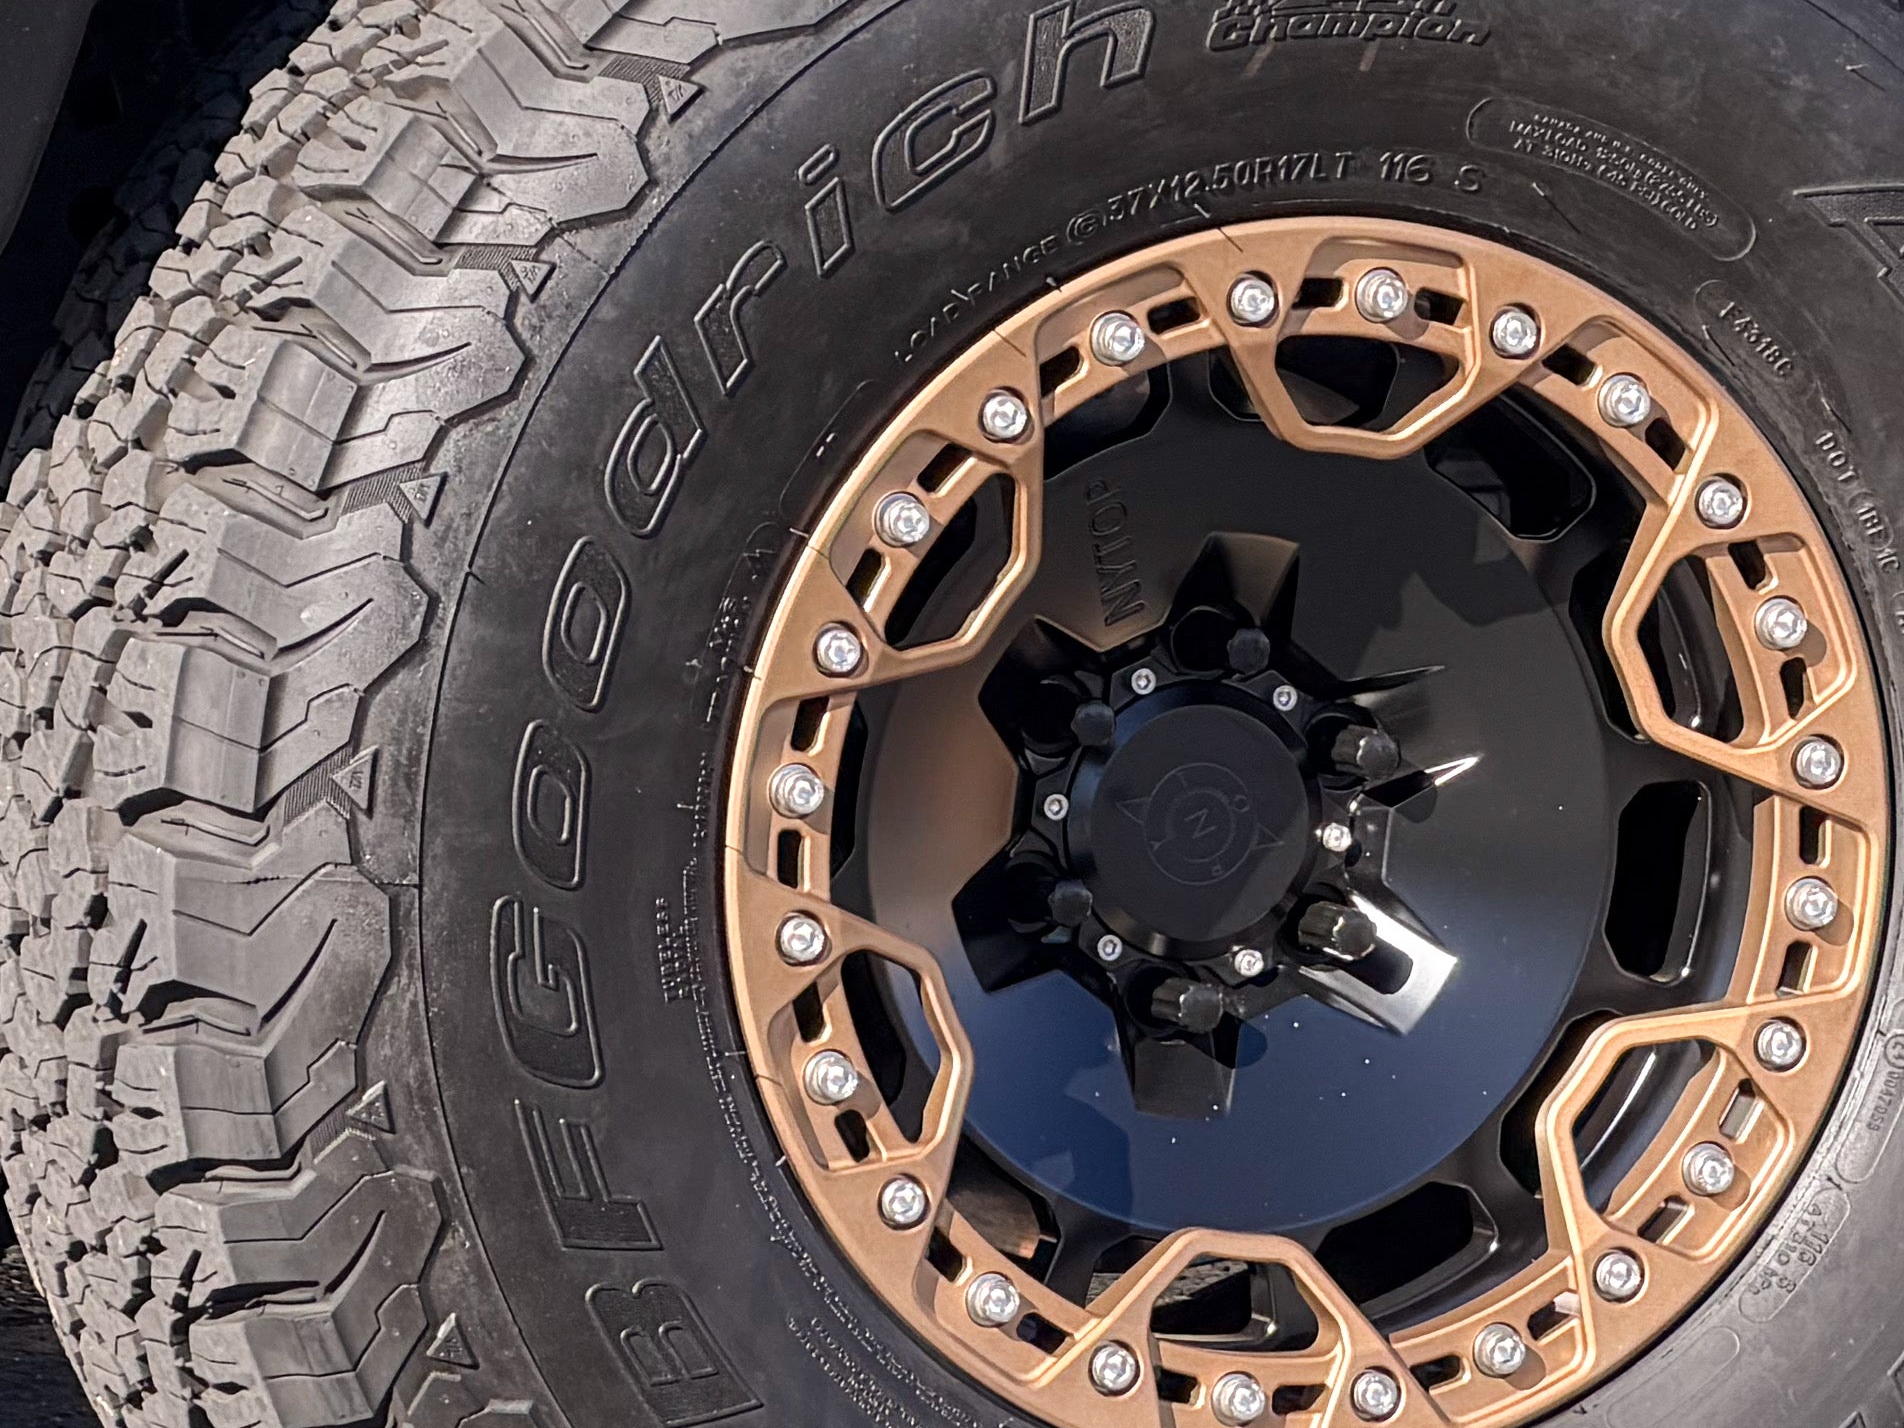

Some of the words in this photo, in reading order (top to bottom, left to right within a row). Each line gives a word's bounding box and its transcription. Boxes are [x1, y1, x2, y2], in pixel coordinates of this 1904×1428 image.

[1206, 10, 1492, 52] Champion
[966, 234, 1059, 305] RANGE
[1377, 152, 1432, 186] 116
[1451, 163, 1483, 194] S
[1814, 429, 1860, 483] DOT
[1083, 477, 1146, 628] NYTOP
